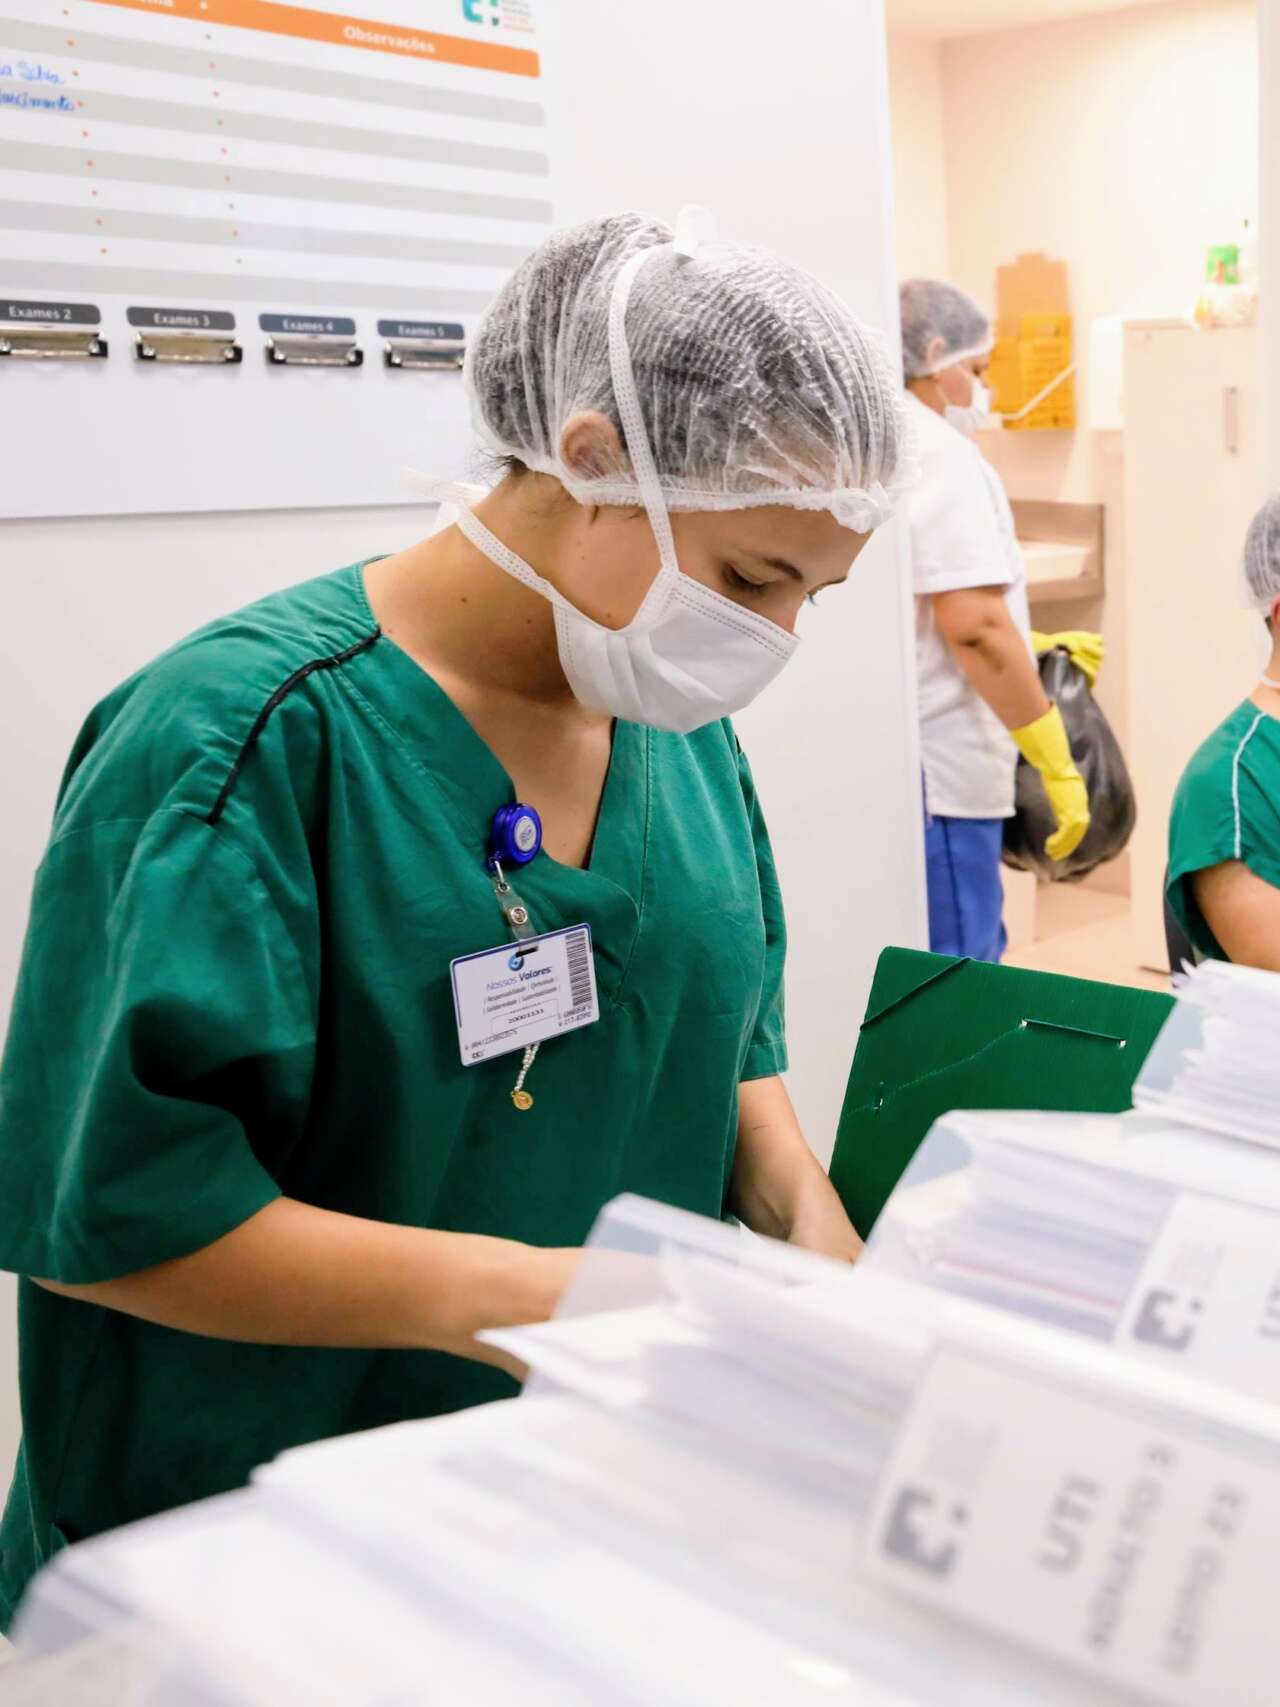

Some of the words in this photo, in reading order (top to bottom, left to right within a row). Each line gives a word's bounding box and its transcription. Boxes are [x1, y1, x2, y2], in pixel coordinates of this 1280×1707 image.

[9, 306, 59, 321] Exames
[62, 308, 72, 321] 2
[153, 312, 198, 328] Exames
[200, 314, 210, 327] 3
[282, 318, 322, 332] Exames
[323, 320, 333, 332] 4
[1036, 1471, 1103, 1574] UTI
